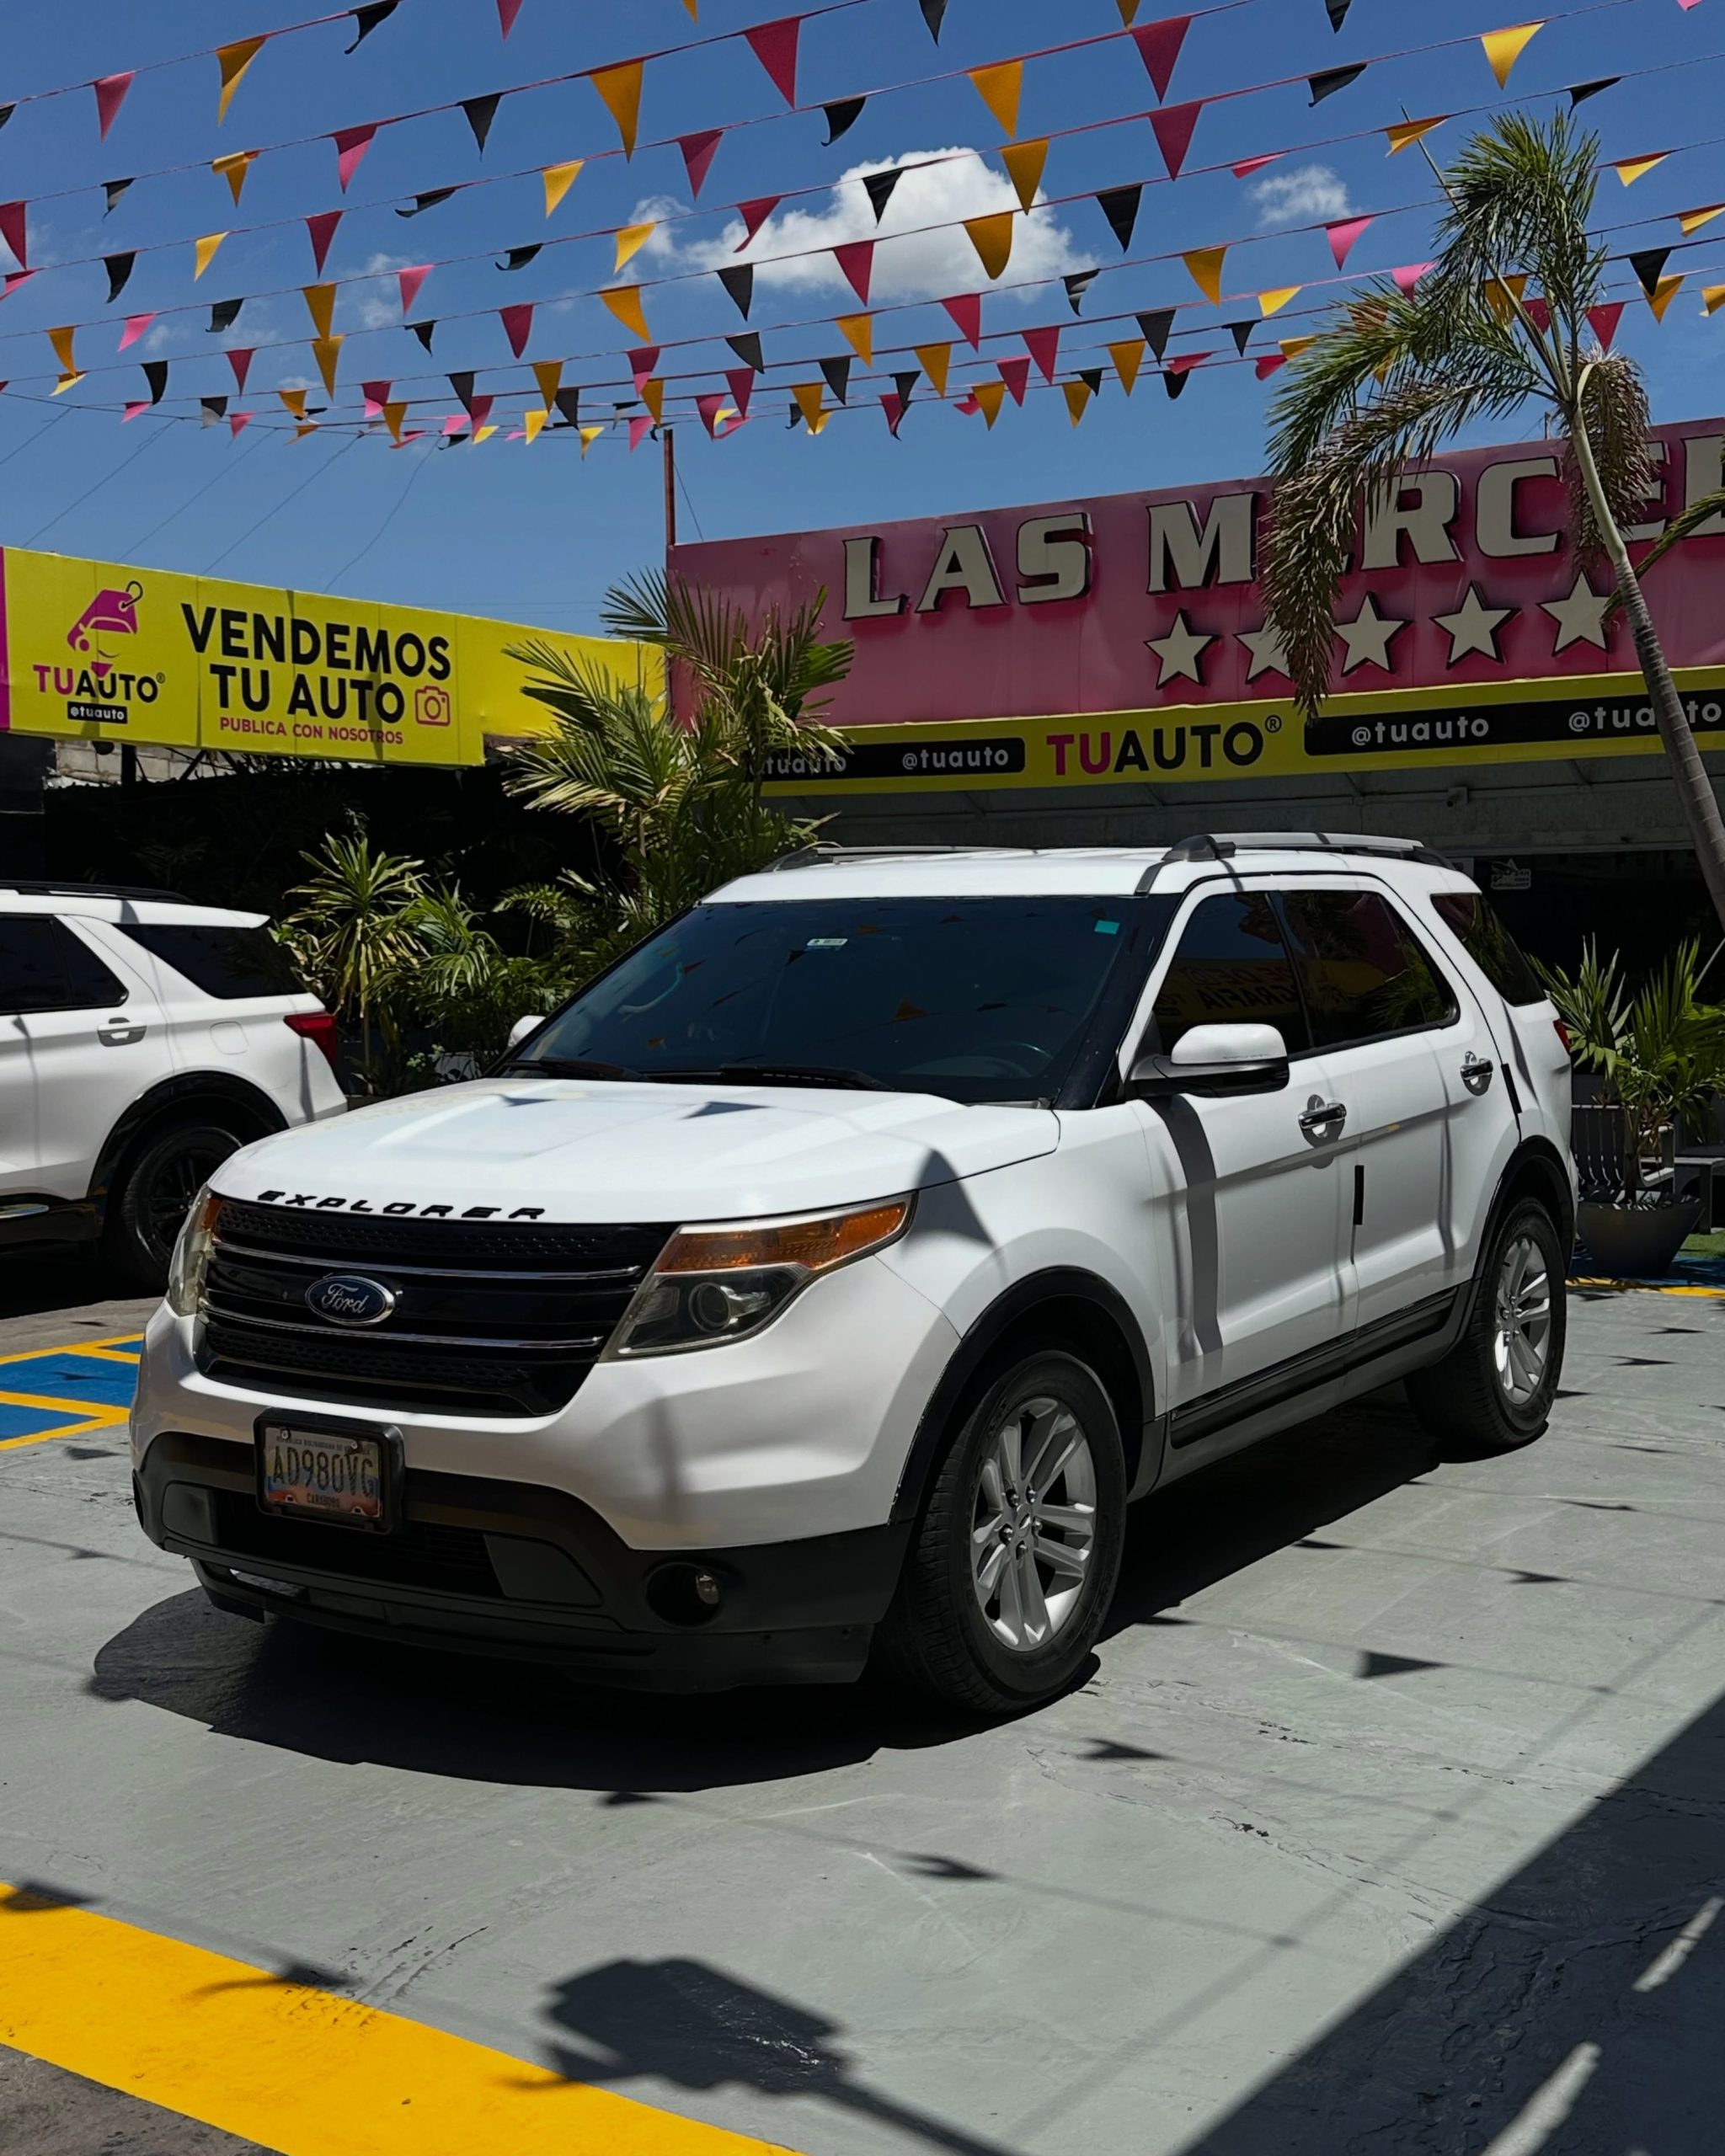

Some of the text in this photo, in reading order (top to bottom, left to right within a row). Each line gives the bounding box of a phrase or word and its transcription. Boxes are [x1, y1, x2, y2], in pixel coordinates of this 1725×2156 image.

[841, 434, 1725, 622] LAS MRC
[180, 602, 452, 681] VENDEMOS
[209, 663, 405, 724] TU AUTO
[70, 706, 126, 721] @tuauto
[1568, 700, 1722, 733] @tuato
[220, 717, 404, 745] PUBLICA CON NOSOTROS
[1351, 714, 1490, 746] @tuauto
[902, 746, 1009, 771] @tuauto
[256, 1190, 546, 1220] EXPLORER
[321, 1283, 369, 1315] Ford
